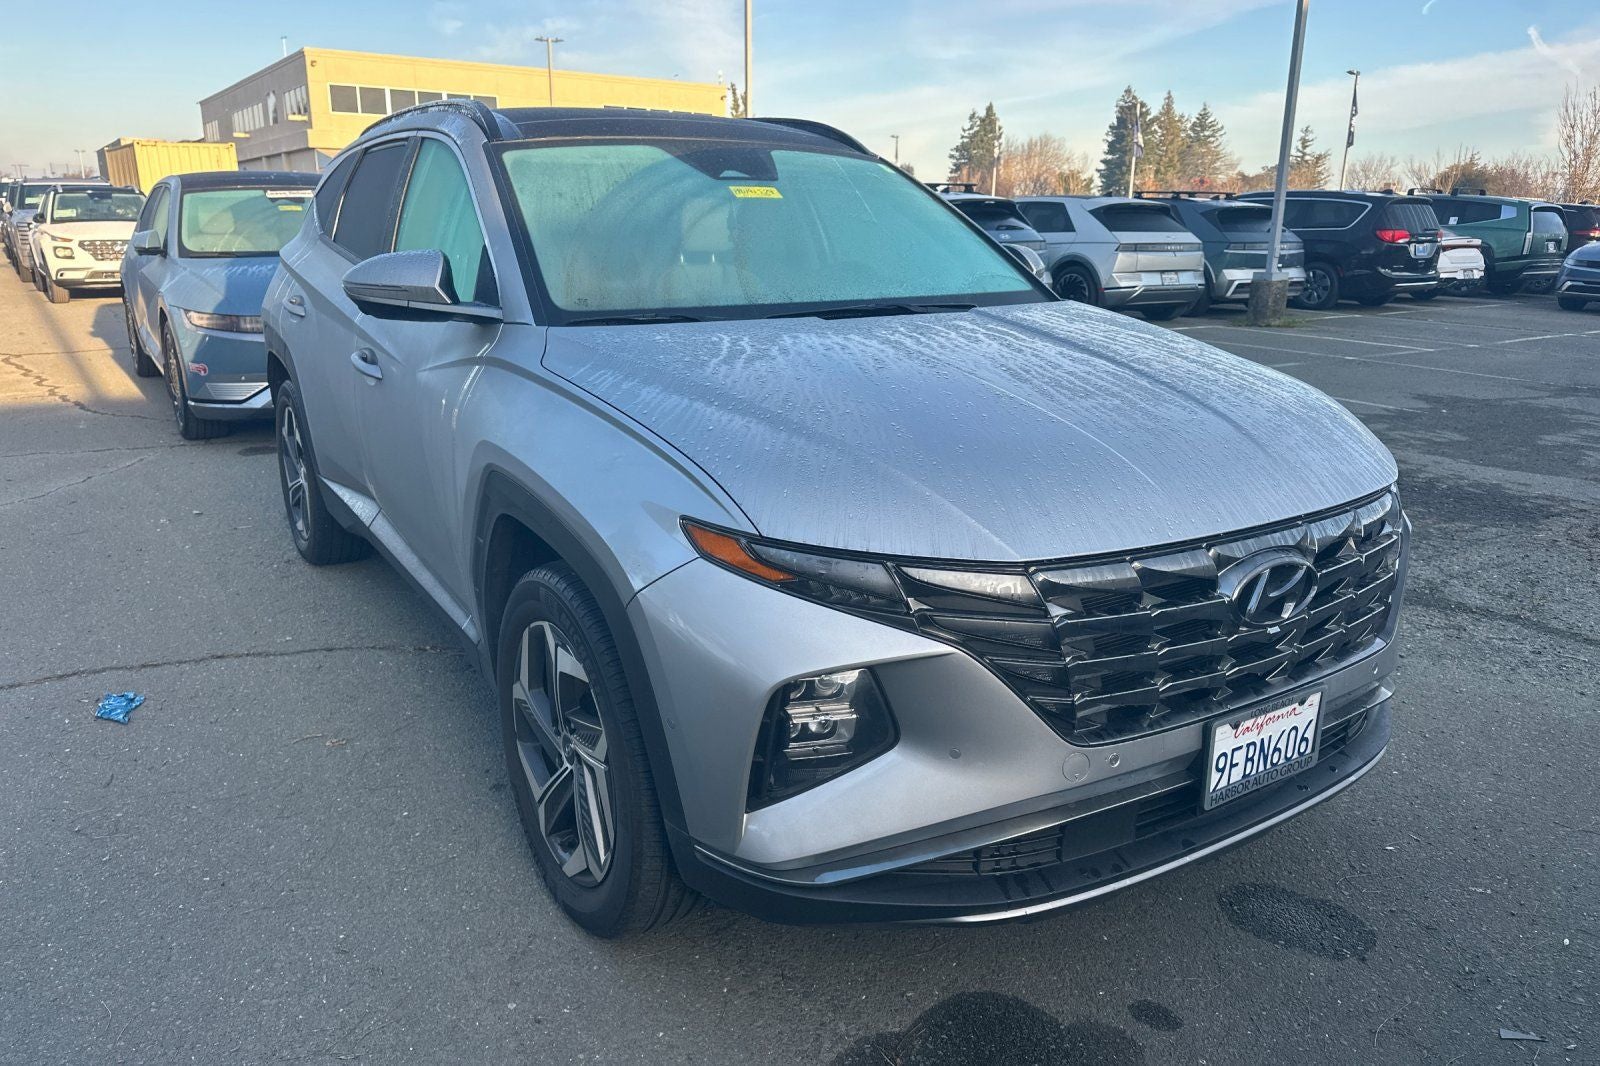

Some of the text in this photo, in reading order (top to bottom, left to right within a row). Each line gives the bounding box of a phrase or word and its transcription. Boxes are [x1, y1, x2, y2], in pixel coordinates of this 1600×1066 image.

[1233, 706, 1303, 739] California
[1250, 697, 1295, 718] LONG BEACH
[1210, 718, 1314, 793] 9FBN606
[1210, 755, 1313, 807] HARBOR AUTO GROUP
